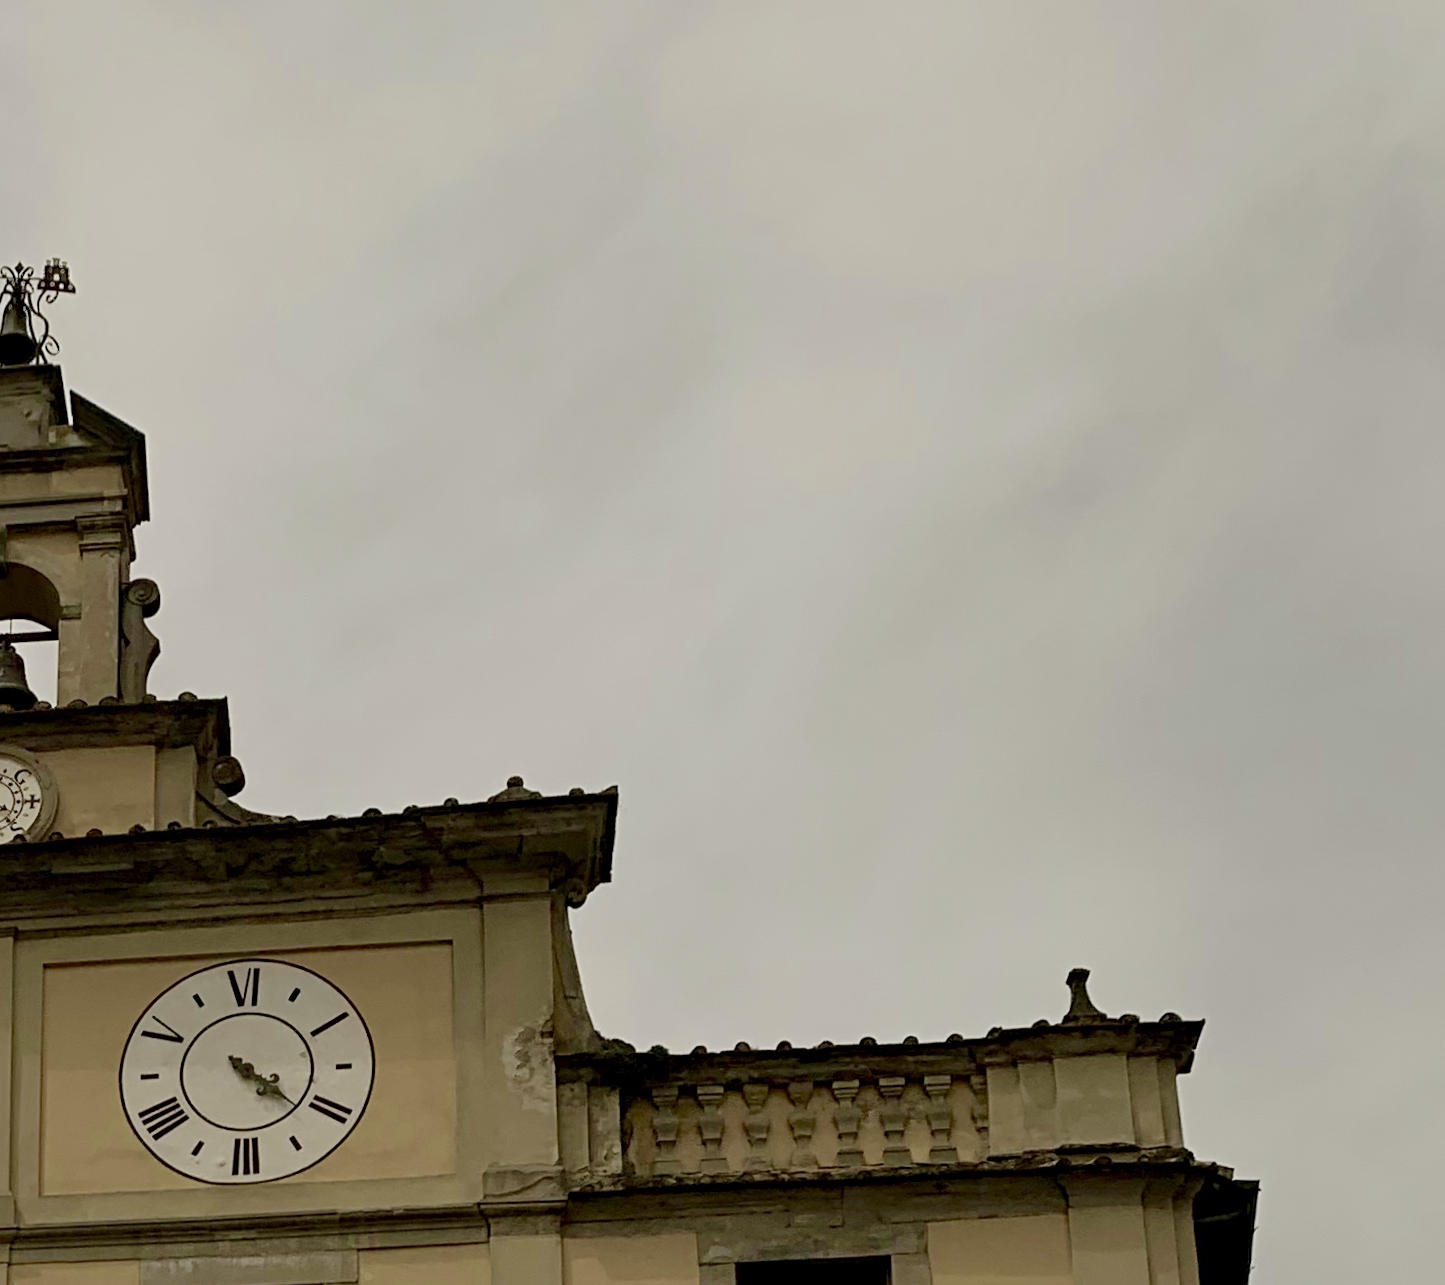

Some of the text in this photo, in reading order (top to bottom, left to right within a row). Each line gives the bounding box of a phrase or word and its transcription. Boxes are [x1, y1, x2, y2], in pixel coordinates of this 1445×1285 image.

[14, 769, 32, 785] G
[228, 968, 260, 1007] VI
[141, 1016, 184, 1043] V
[310, 1012, 349, 1037] I
[138, 1096, 189, 1141] IIII
[308, 1095, 353, 1124] II
[232, 1137, 260, 1175] III
